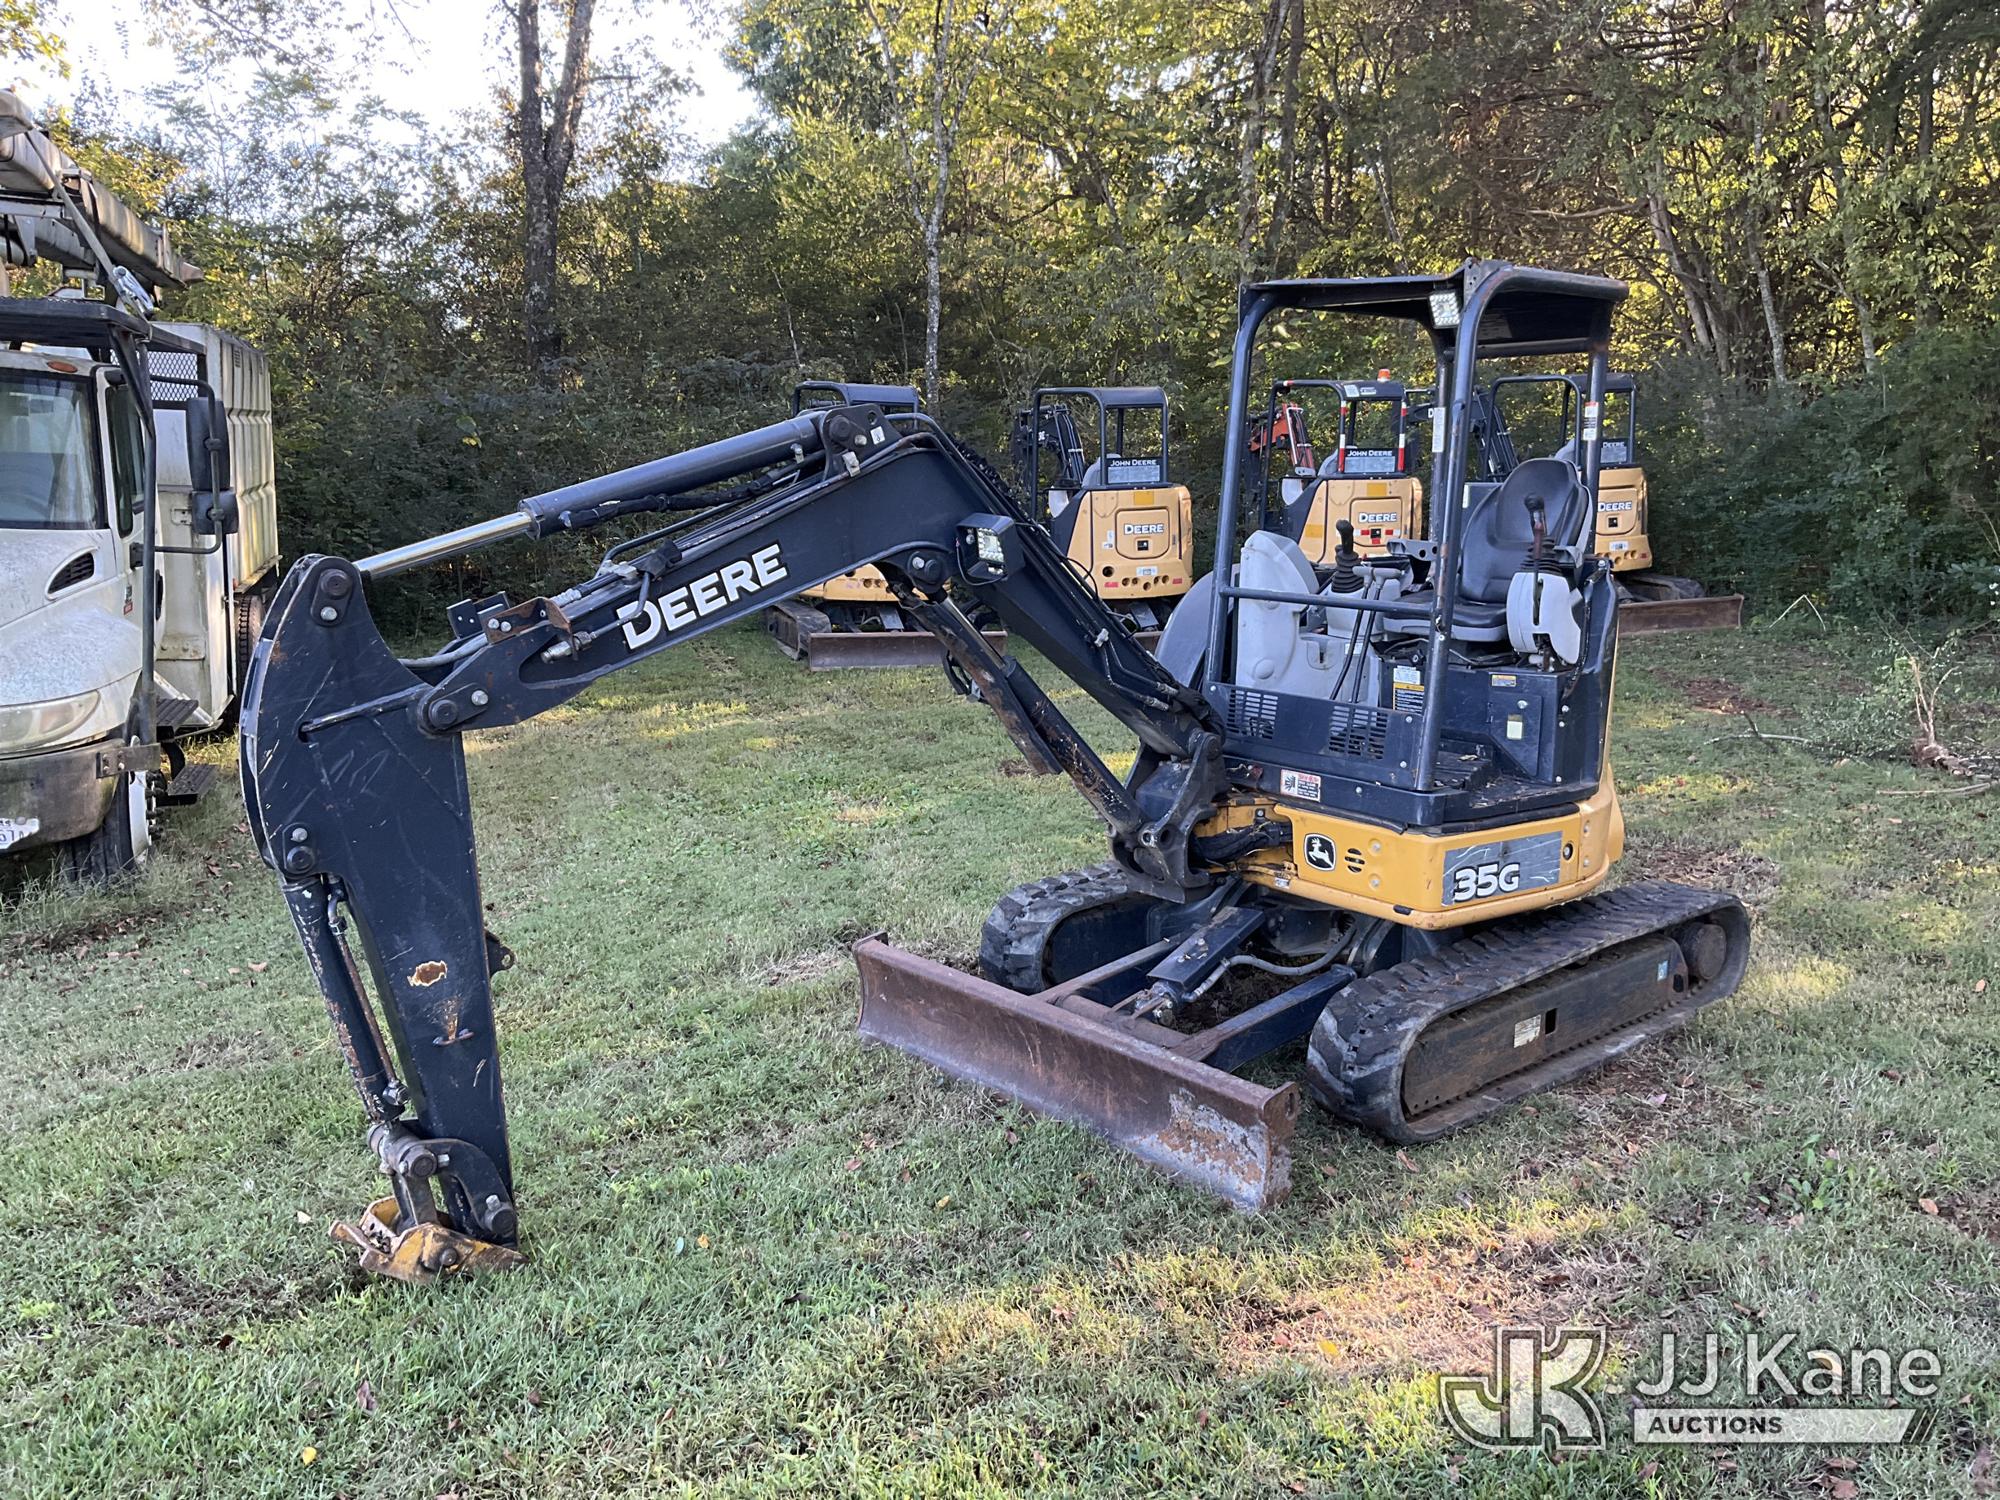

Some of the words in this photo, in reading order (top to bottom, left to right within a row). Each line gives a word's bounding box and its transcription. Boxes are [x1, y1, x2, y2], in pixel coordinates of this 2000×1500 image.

[1598, 502, 1632, 512] DEERE
[1358, 512, 1397, 523] DEERE
[1124, 524, 1164, 535] DEERE
[616, 543, 788, 650] DEERE
[1454, 863, 1520, 902] 35G
